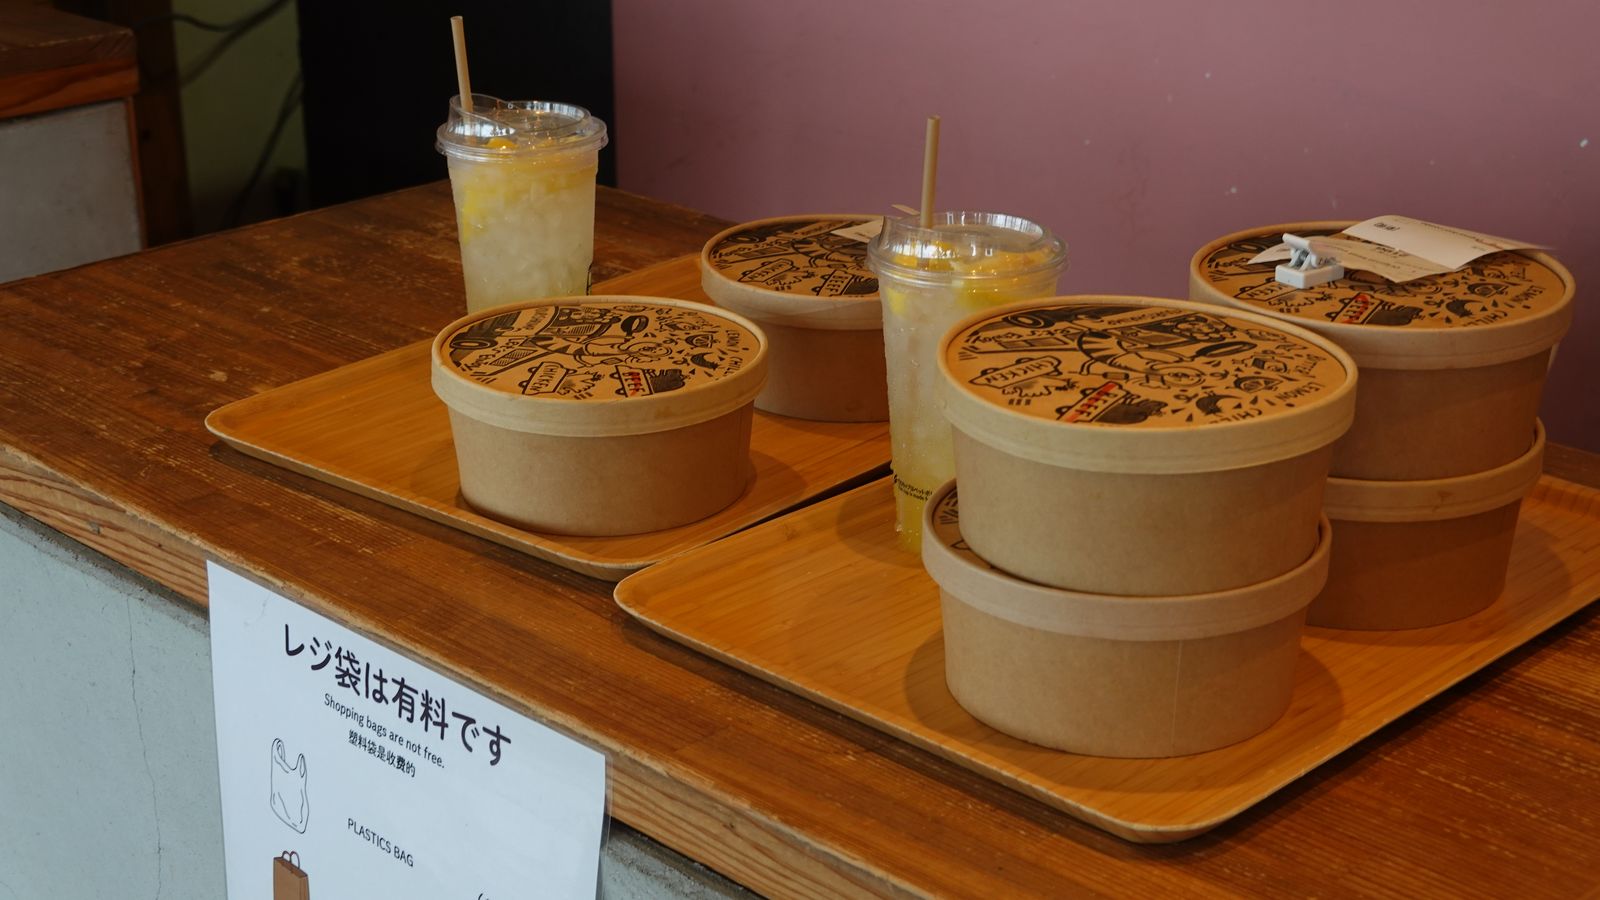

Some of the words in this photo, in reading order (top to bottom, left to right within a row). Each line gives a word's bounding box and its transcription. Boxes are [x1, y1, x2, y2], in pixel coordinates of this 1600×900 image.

[984, 359, 1055, 384] CHICKEN
[1074, 391, 1118, 418] BEEF
[1274, 381, 1326, 402] LEMON
[284, 624, 512, 766] レジ袋は有料です
[324, 693, 365, 728] Shopping
[366, 715, 387, 738] bags
[388, 731, 404, 746] are
[405, 740, 421, 756] not
[423, 747, 445, 769] free.
[347, 818, 392, 854] PLASTICS
[393, 844, 415, 868] BAG
